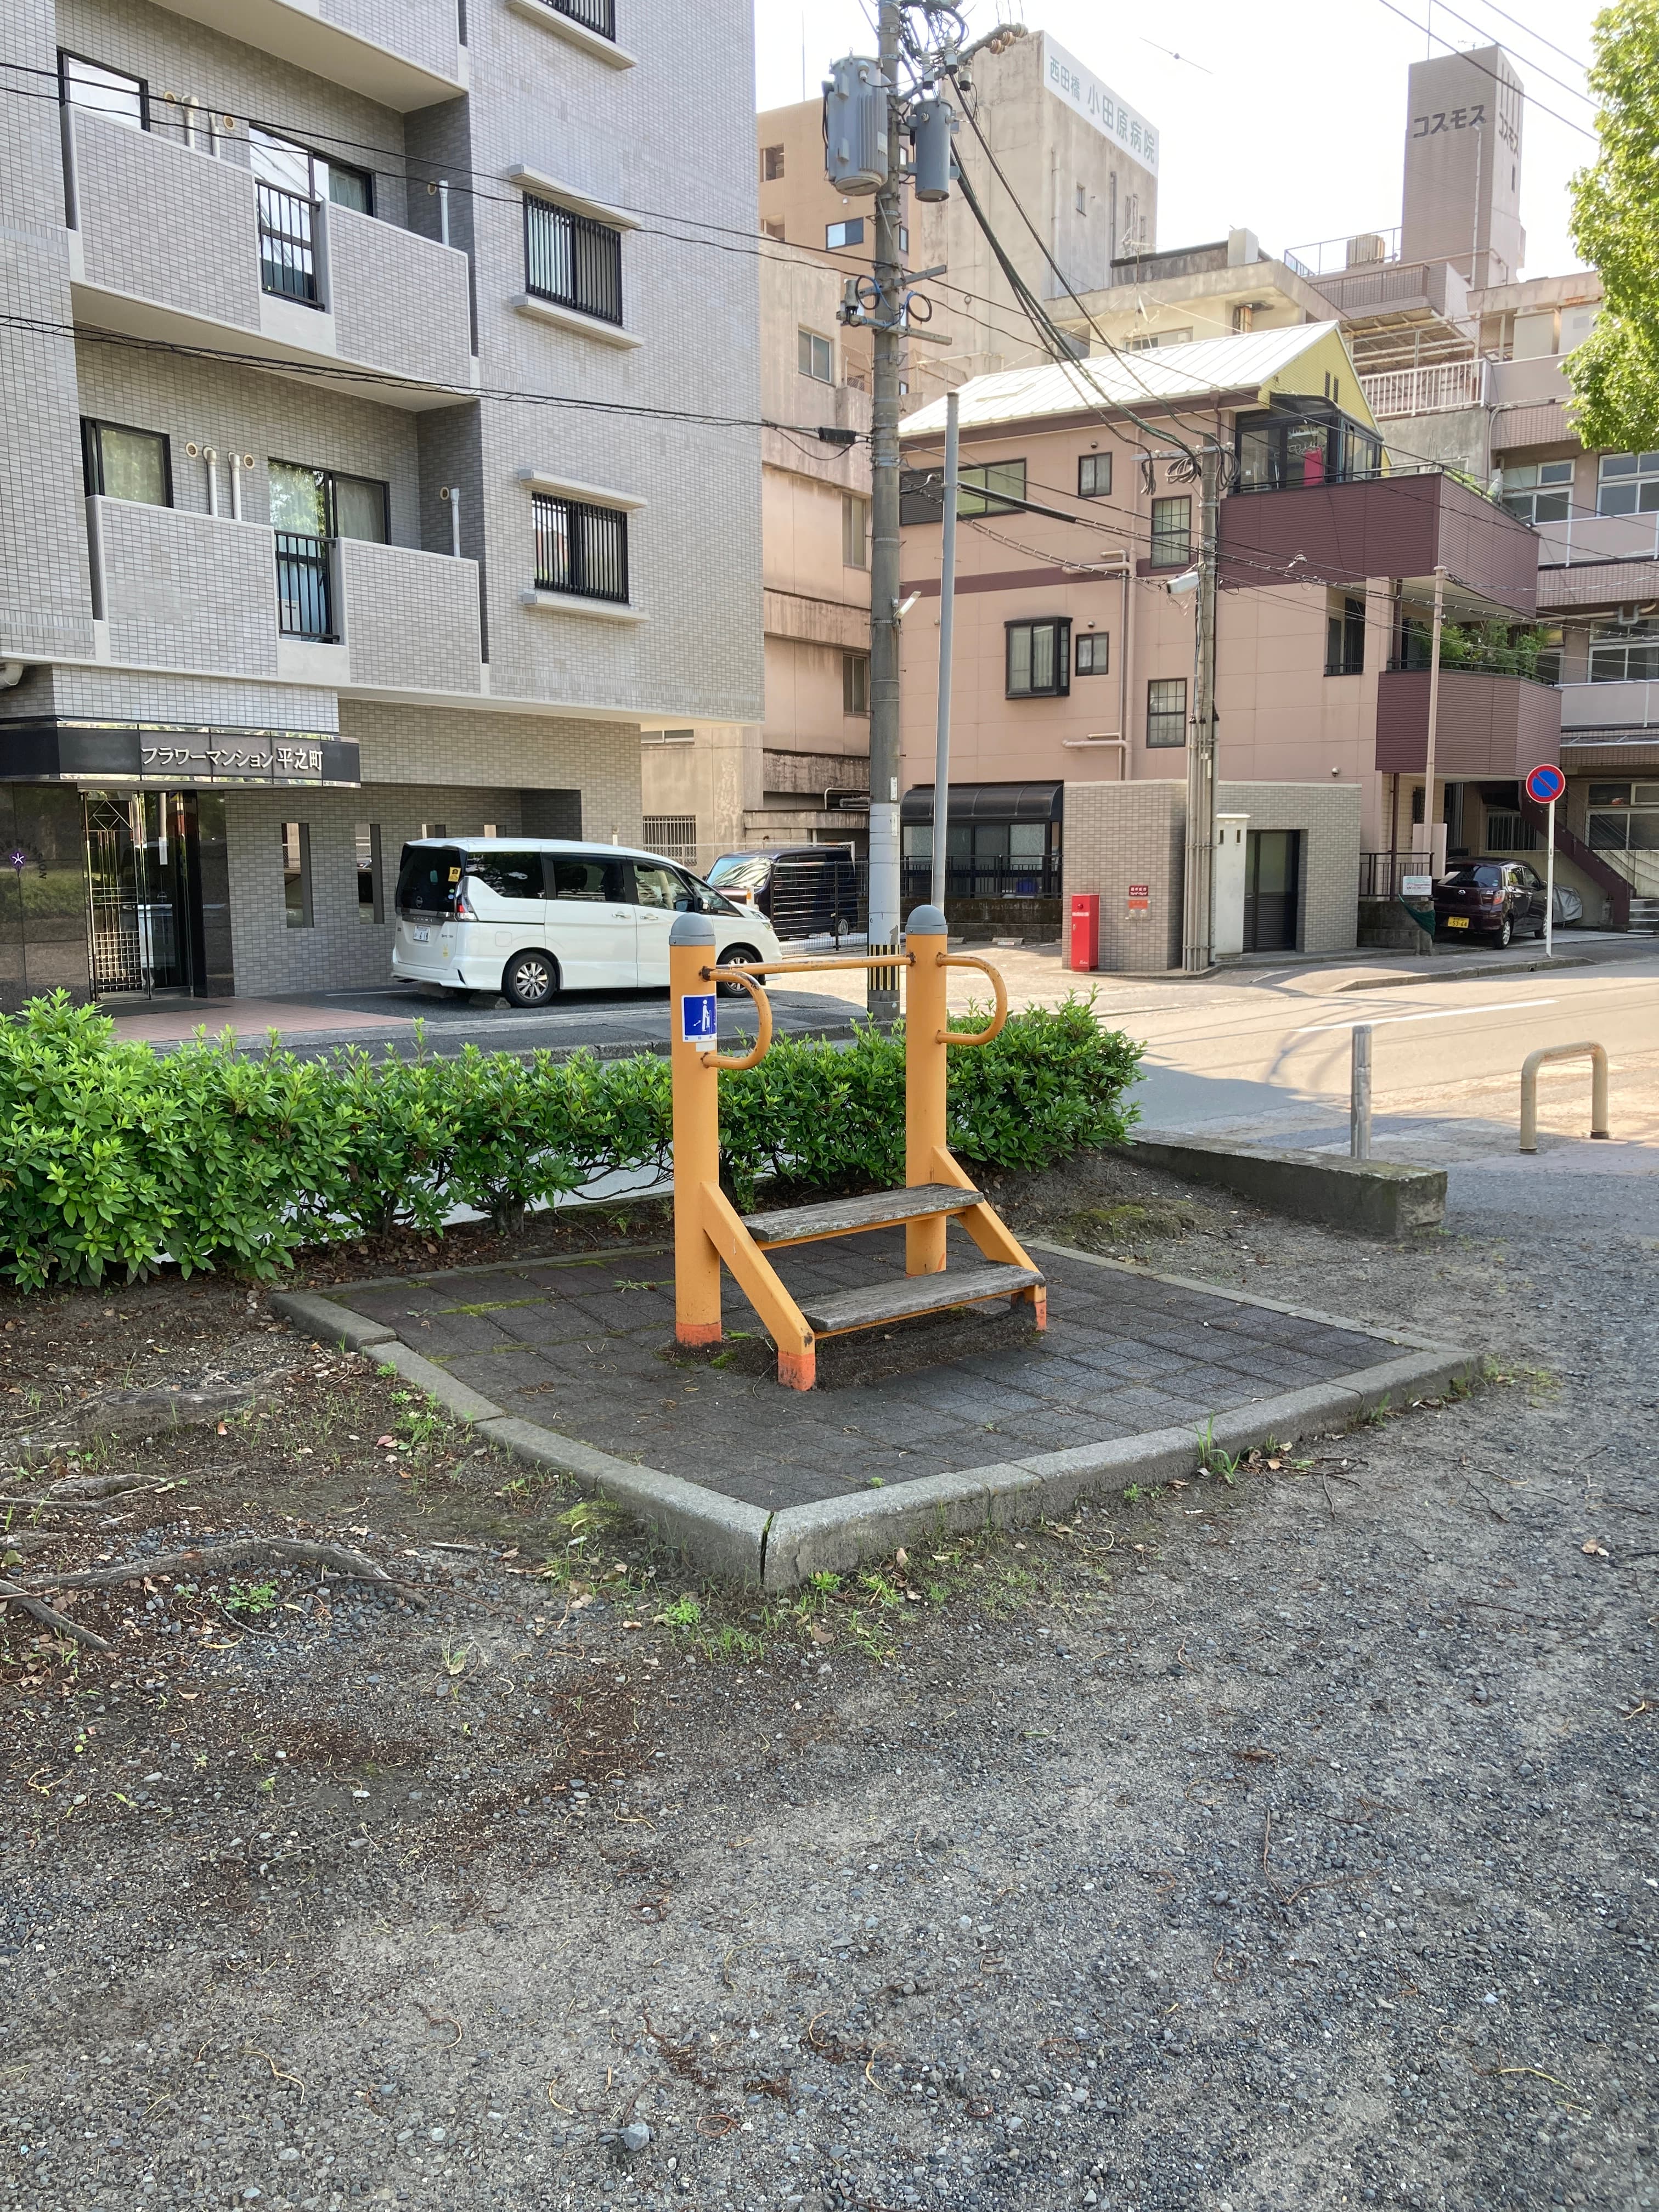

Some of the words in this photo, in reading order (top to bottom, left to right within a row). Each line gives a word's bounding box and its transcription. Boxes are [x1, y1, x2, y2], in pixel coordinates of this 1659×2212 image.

[1050, 55, 1080, 101] 西田橋
[1088, 84, 1155, 163] 小田原病院
[1413, 105, 1486, 138] コスモス
[1499, 111, 1519, 159] コスモス
[141, 747, 273, 769] フラワーマンション
[277, 747, 323, 771] 平之町
